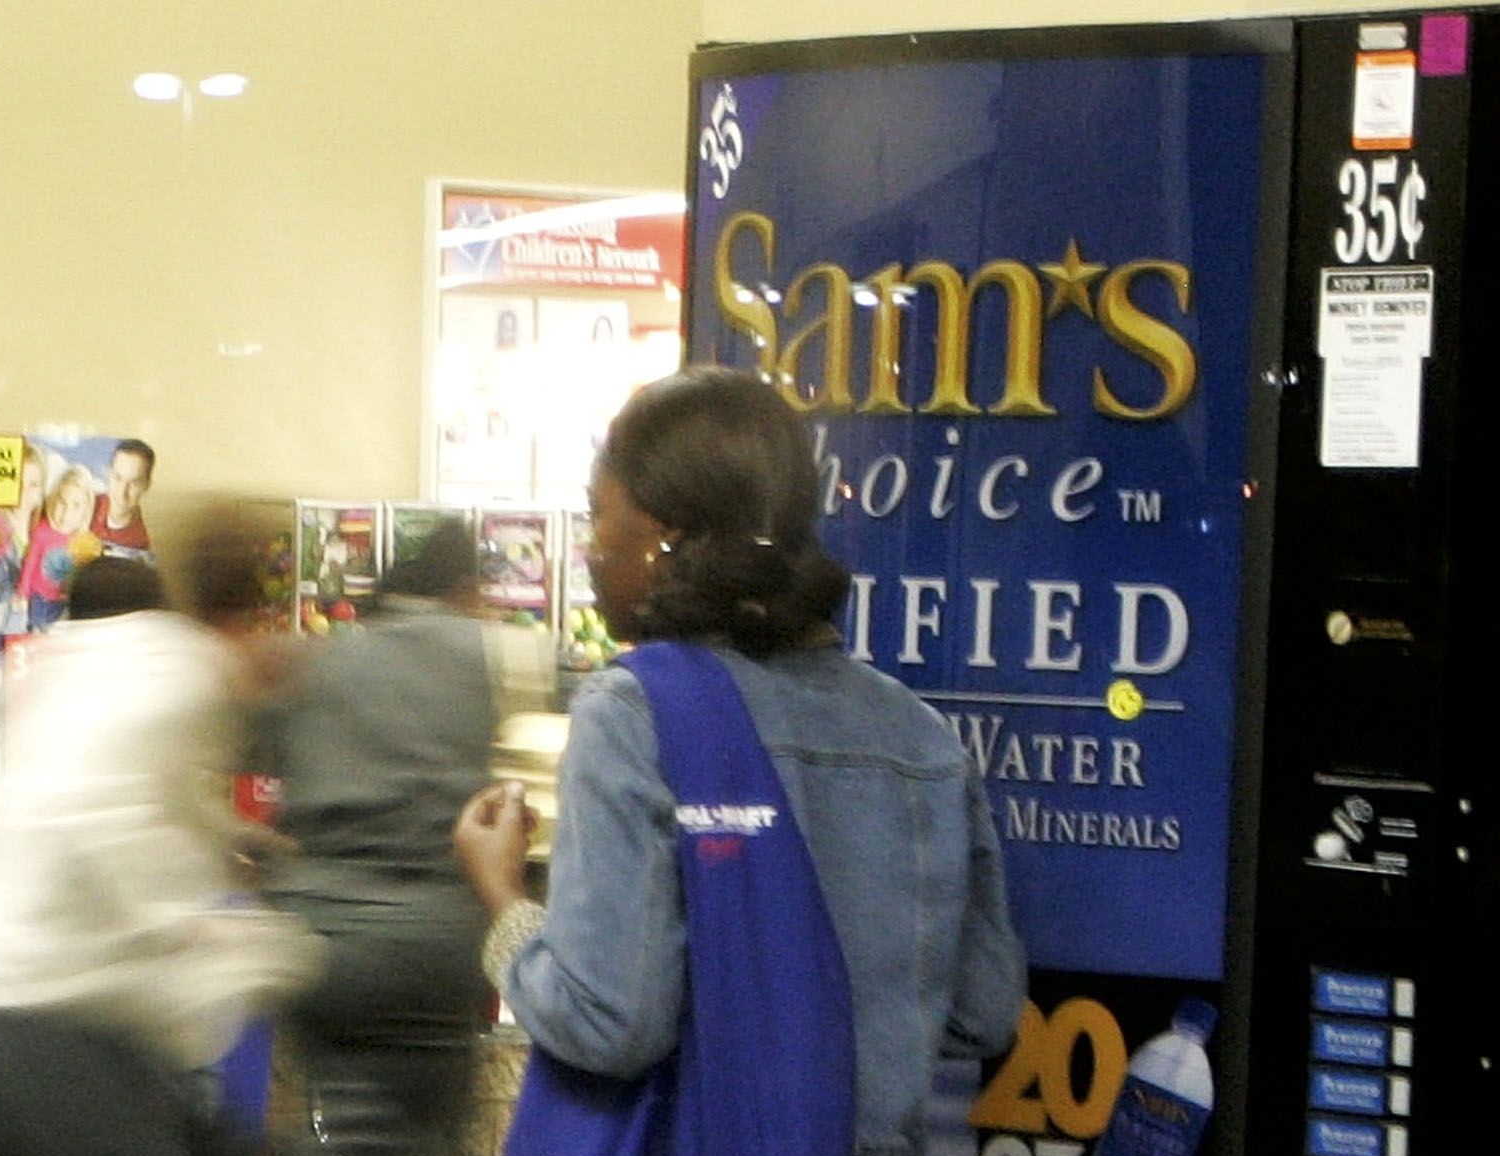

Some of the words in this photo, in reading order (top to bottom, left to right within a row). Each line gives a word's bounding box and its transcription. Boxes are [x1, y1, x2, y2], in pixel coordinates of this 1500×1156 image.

[812, 425, 1103, 522] hoice
[850, 573, 1190, 675] IFIED
[947, 713, 1146, 788] WATER
[1005, 796, 1182, 851] MINERALS
